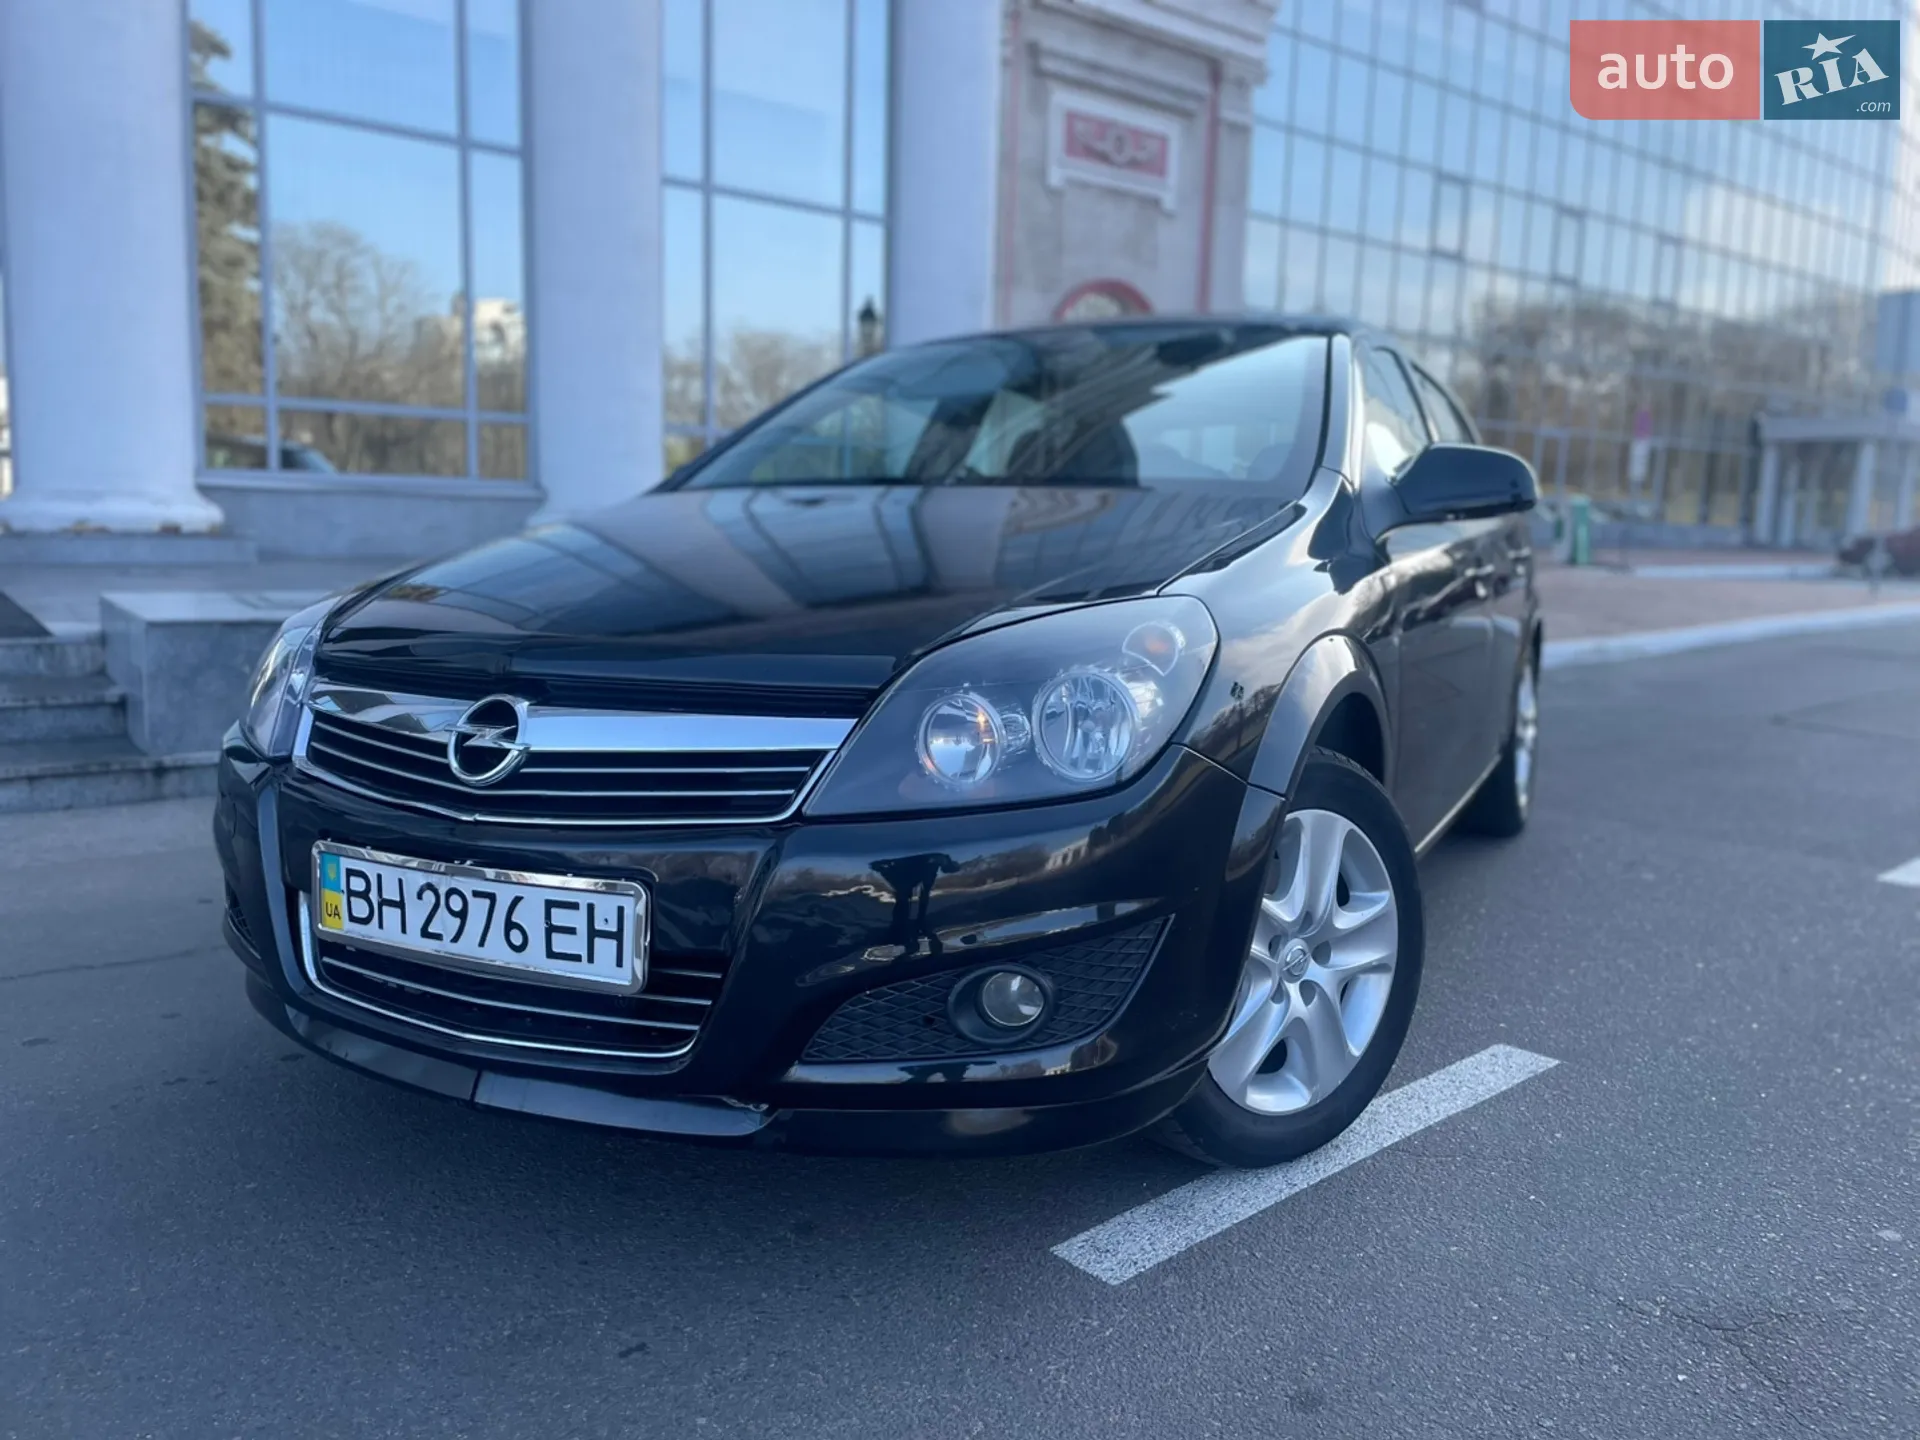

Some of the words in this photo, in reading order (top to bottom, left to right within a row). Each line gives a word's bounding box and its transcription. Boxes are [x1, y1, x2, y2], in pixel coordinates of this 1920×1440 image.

[325, 903, 341, 920] UA
[345, 867, 407, 934] BH
[417, 881, 529, 953] 2976
[544, 898, 625, 968] EH
